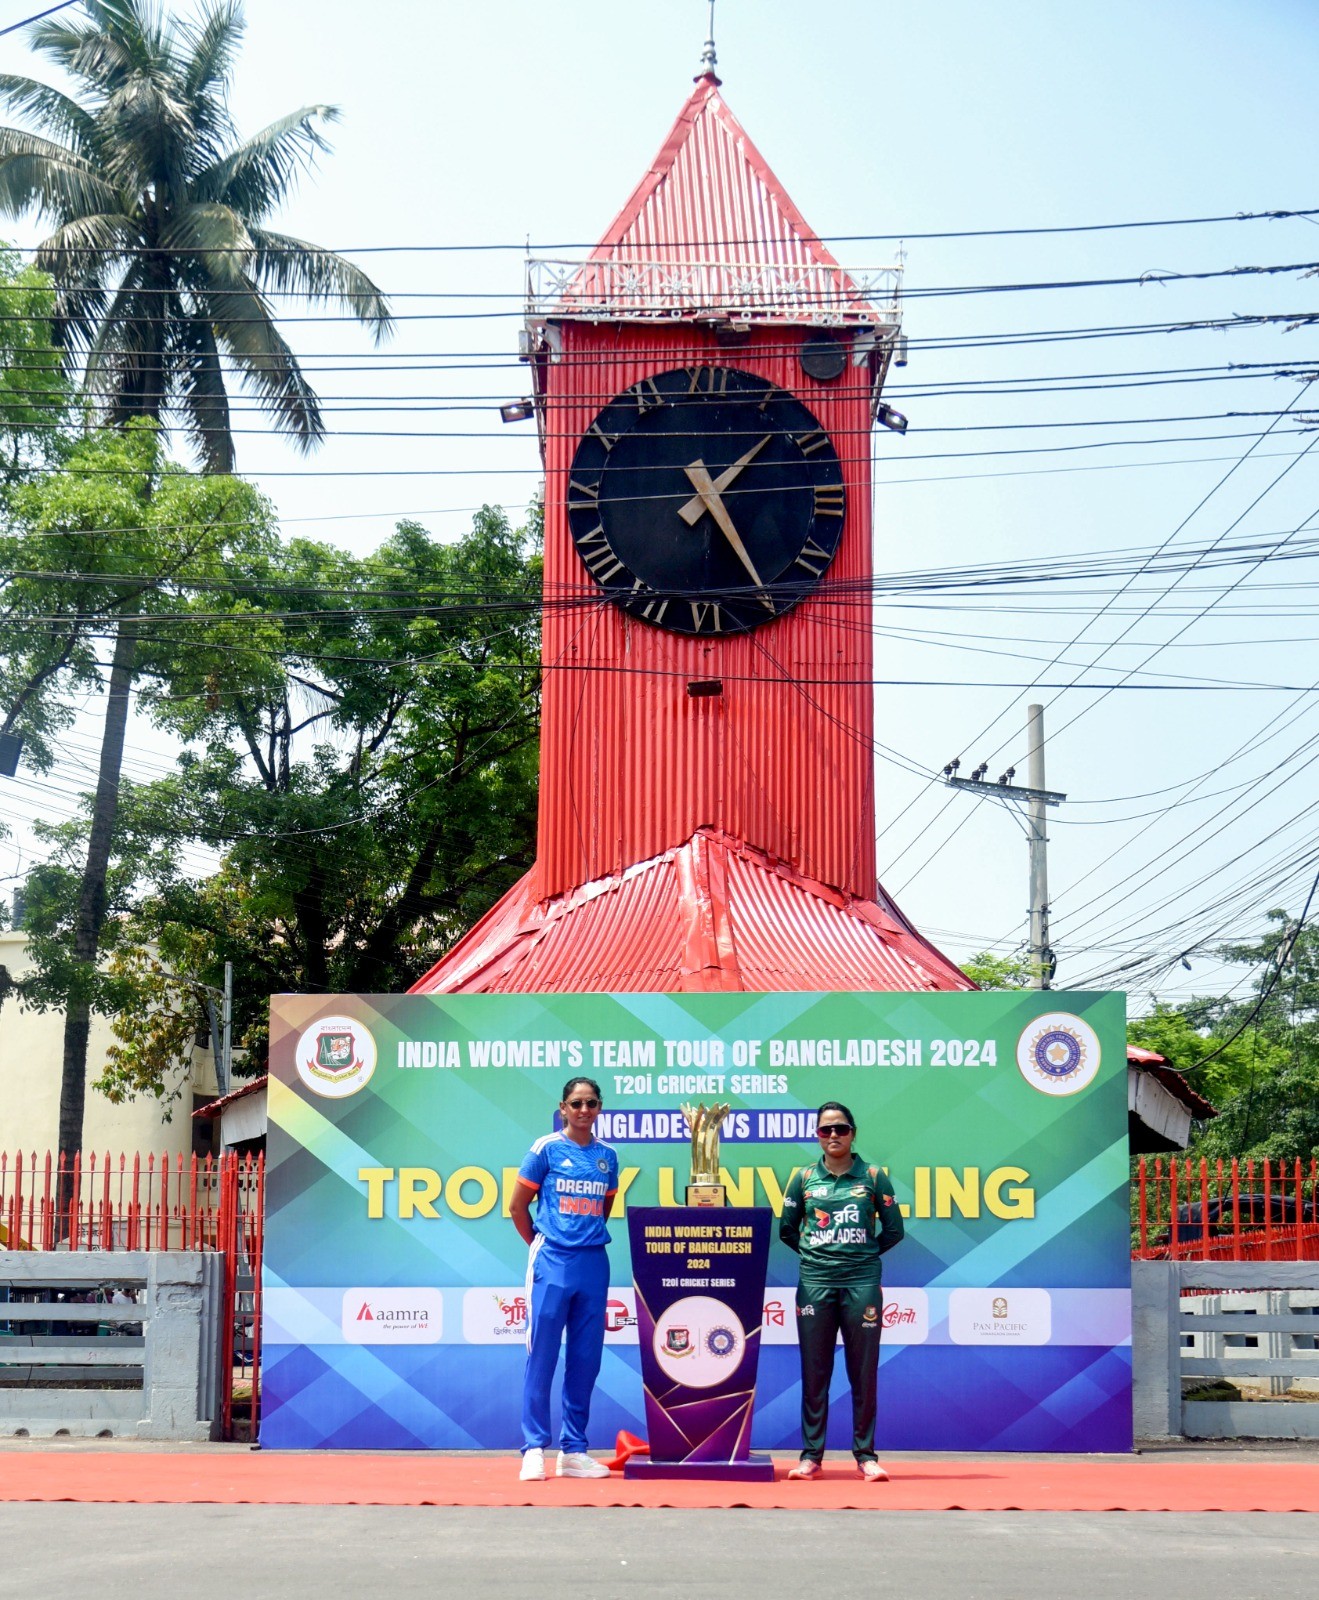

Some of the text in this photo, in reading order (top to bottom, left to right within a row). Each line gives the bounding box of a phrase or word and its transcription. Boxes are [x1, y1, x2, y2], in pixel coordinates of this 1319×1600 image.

[397, 1039, 998, 1068] INDIA WOMEN'S TEAM TOUR OF BANGLADESH 2024
[657, 1074, 726, 1094] CRICKET
[730, 1074, 788, 1094] SERIES
[722, 1113, 750, 1139] VS
[758, 1113, 819, 1138] INDIA
[832, 1204, 860, 1226] রবি
[644, 1226, 753, 1238] INDIA WOMEN'S TEAM
[809, 1228, 867, 1246] BANGLADESH
[645, 1242, 752, 1253] TOUR OF BANGLADESH
[687, 1259, 711, 1269] 2024
[680, 1278, 709, 1287] CRICKET
[710, 1278, 736, 1287] SERIES
[376, 1310, 429, 1321] aamra
[973, 1322, 1028, 1331] PAN PACIFIC
